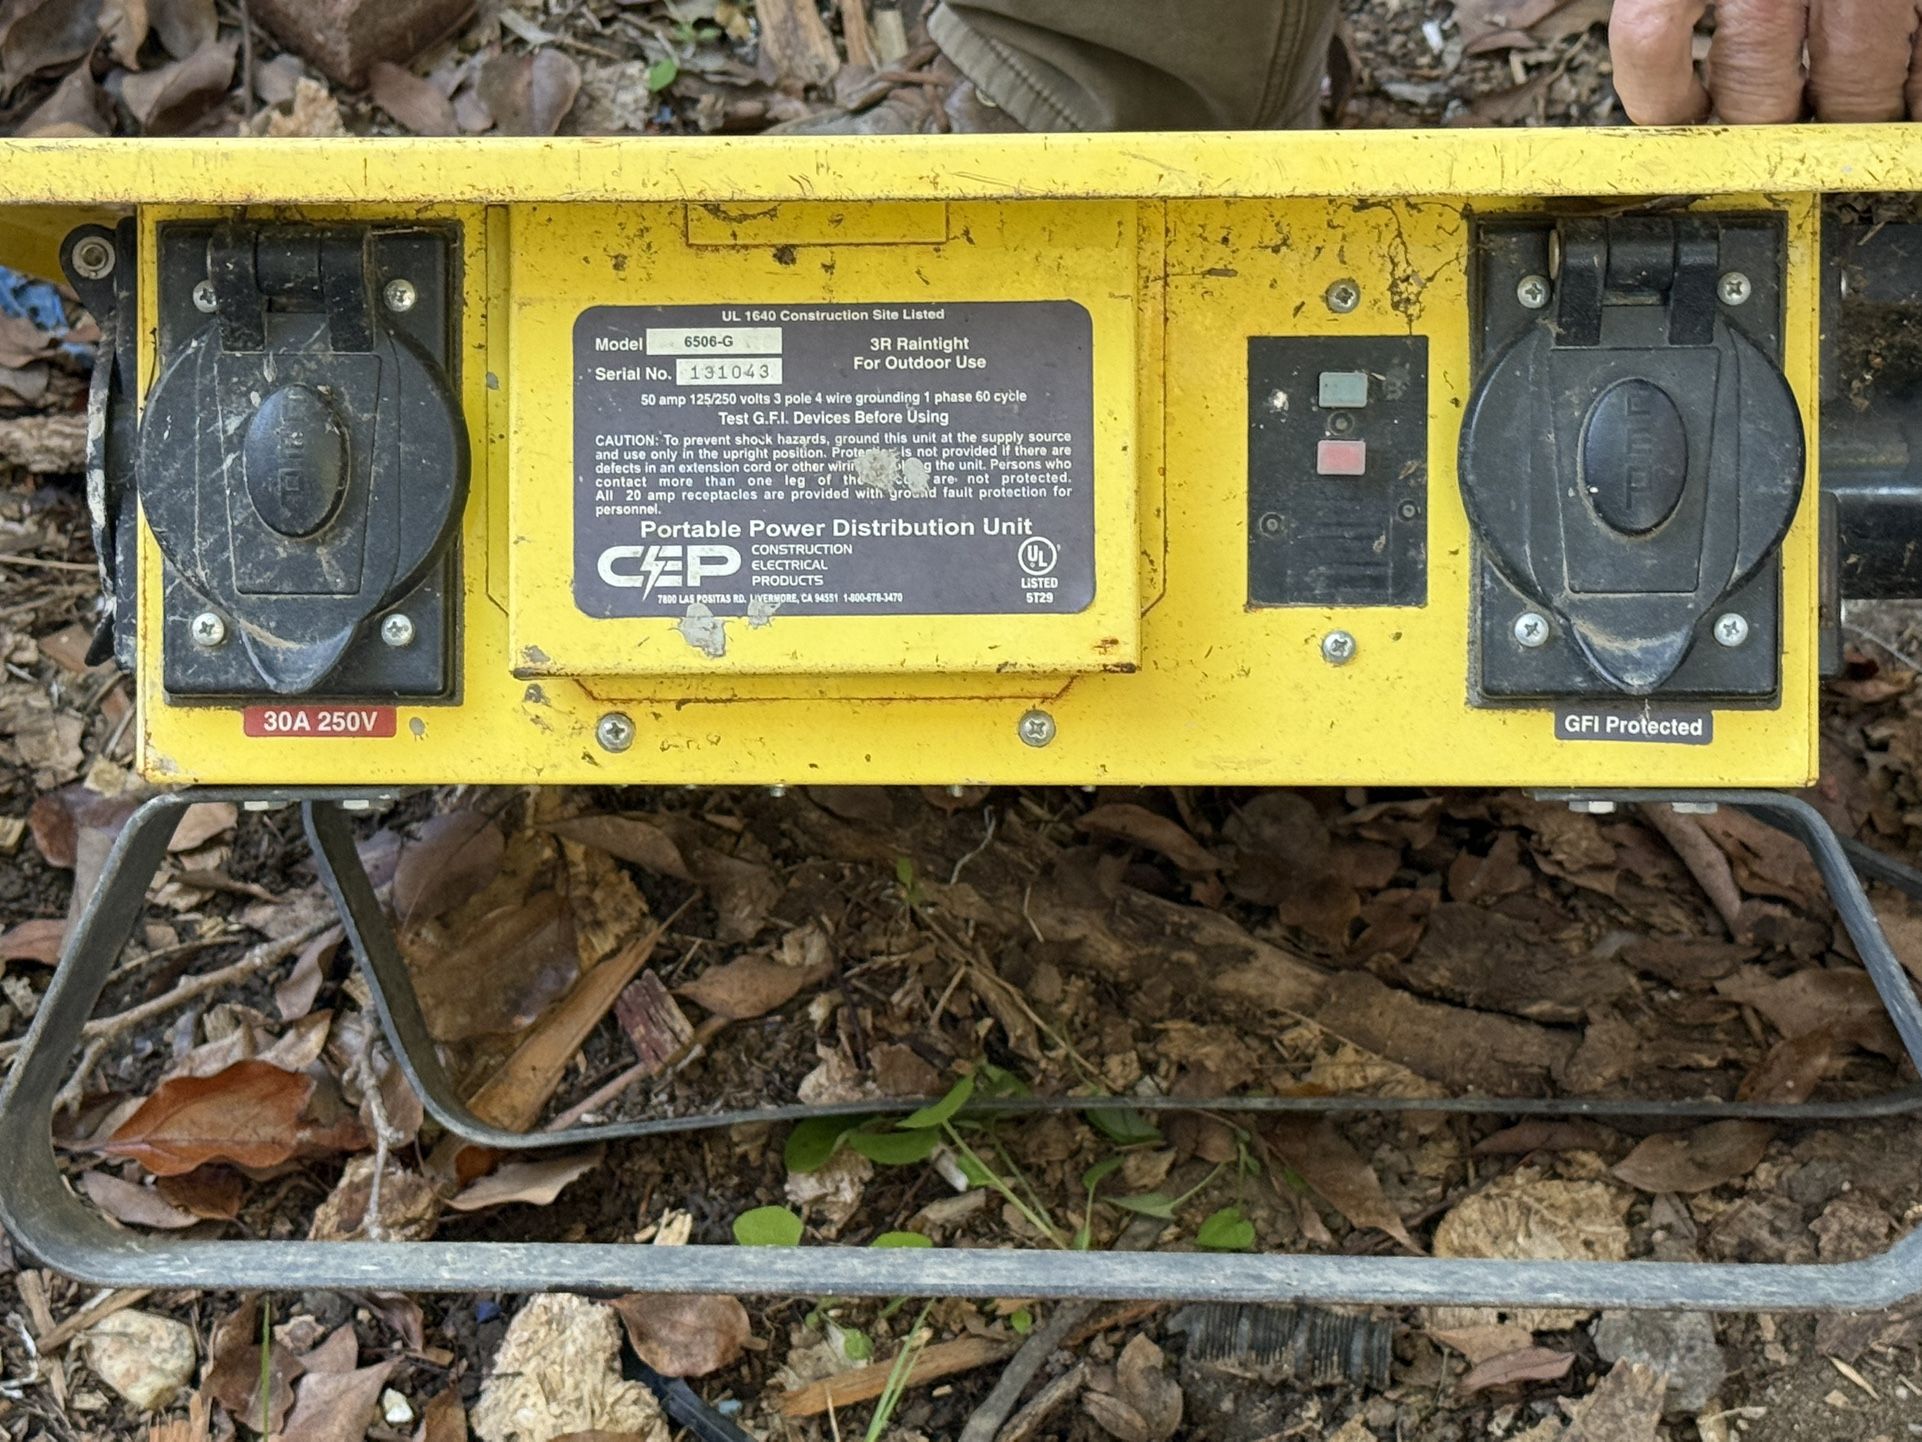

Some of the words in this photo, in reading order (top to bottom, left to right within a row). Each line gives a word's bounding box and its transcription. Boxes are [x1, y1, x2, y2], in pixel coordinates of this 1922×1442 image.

[722, 310, 741, 321] UL
[745, 310, 776, 321] 1640
[780, 309, 868, 321] Construction
[872, 310, 898, 320] Site
[903, 308, 944, 320] Listed
[595, 337, 643, 351] Model
[684, 335, 734, 348] 6506-G
[870, 338, 892, 351] 3R
[897, 336, 970, 354] Raintight
[854, 356, 880, 370] For
[885, 356, 951, 370] Outdoor
[956, 355, 987, 369] Use
[595, 367, 640, 381] Serial
[645, 367, 672, 380] No.
[690, 364, 770, 380] 131043
[641, 394, 656, 406] 50
[659, 396, 686, 408] amp
[690, 394, 737, 406] 125/250
[740, 393, 770, 405] volts
[773, 394, 782, 404] 3
[784, 392, 811, 407] pole
[814, 393, 822, 404] 4
[826, 392, 852, 404] wire
[855, 392, 920, 406] grounding
[924, 392, 930, 403] 1
[934, 391, 973, 405] phase
[975, 391, 991, 402] 60
[994, 390, 1027, 404] cycle
[719, 412, 749, 425] Test
[753, 412, 789, 425] G.F.I.
[793, 411, 850, 424] Devices
[854, 410, 902, 424] Before
[906, 410, 949, 426] Using
[596, 434, 659, 446] CAUTION:
[663, 434, 679, 446] To
[684, 434, 731, 449] prevent
[735, 434, 772, 446] shock
[778, 433, 830, 447] hazards,
[835, 432, 880, 447] ground
[884, 432, 908, 444] this
[912, 432, 936, 444] unit
[940, 432, 953, 443] at
[957, 432, 977, 443] the
[982, 431, 1024, 445] supply
[1028, 432, 1072, 442] source
[596, 449, 619, 460] and
[624, 450, 646, 460] use
[650, 448, 678, 462] only
[682, 448, 694, 459] in
[698, 449, 718, 460] the
[723, 448, 768, 462] upright
[772, 447, 827, 459] position.
[832, 446, 896, 458] Prote
[902, 446, 912, 457] is
[917, 446, 938, 458] not
[942, 445, 997, 458] provided
[1002, 445, 1011, 456] if
[1014, 445, 1048, 456] there
[1052, 447, 1072, 456] are
[596, 462, 642, 474] defects
[645, 462, 656, 473] in
[660, 464, 675, 474] an
[678, 462, 740, 474] extension
[743, 462, 772, 472] cord
[775, 463, 788, 472] or
[792, 461, 825, 472] other
[936, 459, 955, 470] the
[958, 459, 986, 470] unit.
[990, 458, 1042, 470] Persons
[1045, 458, 1072, 470] who
[596, 476, 647, 488] contact
[659, 477, 694, 487] more
[705, 476, 736, 487] than
[748, 476, 773, 486] one
[784, 475, 806, 488] leg
[818, 474, 832, 486] of
[934, 475, 955, 484] are
[967, 474, 990, 484] not
[1002, 472, 1072, 486] protected.
[596, 490, 614, 501] All
[626, 490, 642, 501] 20
[648, 492, 676, 503] amp
[682, 489, 758, 503] receptacles
[764, 490, 785, 500] are
[791, 488, 850, 502] provided
[855, 487, 883, 499] with
[943, 486, 973, 498] fault
[979, 486, 1047, 500] protection
[1053, 486, 1072, 498] for
[596, 503, 662, 518] personnel.
[640, 520, 742, 538] Portable
[750, 520, 826, 538] Power
[833, 518, 975, 536] Distribution
[982, 518, 1033, 536] Unit
[751, 544, 852, 555] CONSTRUCTION
[1027, 544, 1048, 567] UL
[597, 544, 742, 594] CEP
[751, 559, 828, 570] ELECTRICAL
[752, 574, 824, 586] PRODUCTS
[658, 594, 677, 604] 7800
[678, 594, 694, 604] LAS
[696, 594, 732, 604] POSITAS
[732, 594, 746, 604] RD.
[801, 593, 813, 602] CA
[1026, 592, 1054, 604] 5T29
[264, 710, 310, 732] 30A
[317, 711, 378, 732] 250V
[1565, 714, 1600, 732] GFI
[1606, 716, 1703, 736] Protected
